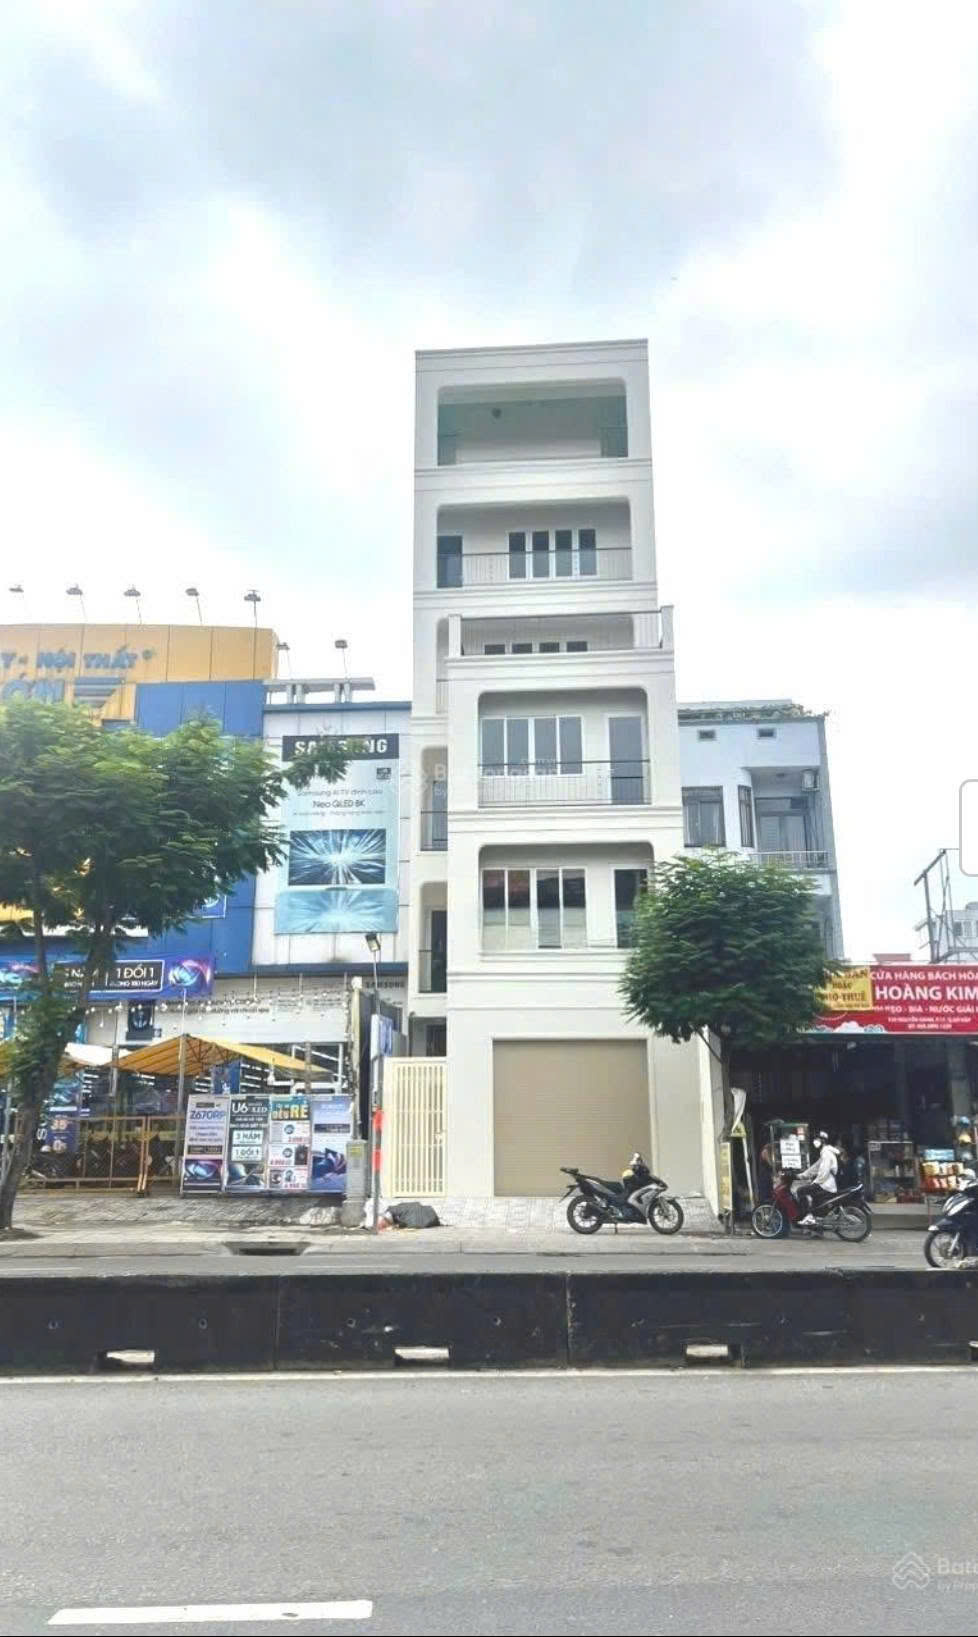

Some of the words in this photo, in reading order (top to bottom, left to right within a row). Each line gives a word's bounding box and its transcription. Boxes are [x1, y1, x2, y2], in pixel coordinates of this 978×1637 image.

[83, 645, 138, 669] THẤT
[870, 970, 893, 980] CỬA
[894, 970, 926, 980] HÀNG
[927, 971, 956, 980] BÁCH
[875, 982, 942, 1000] HOÀNG
[946, 985, 978, 1000] KIM
[232, 1102, 248, 1113] U6
